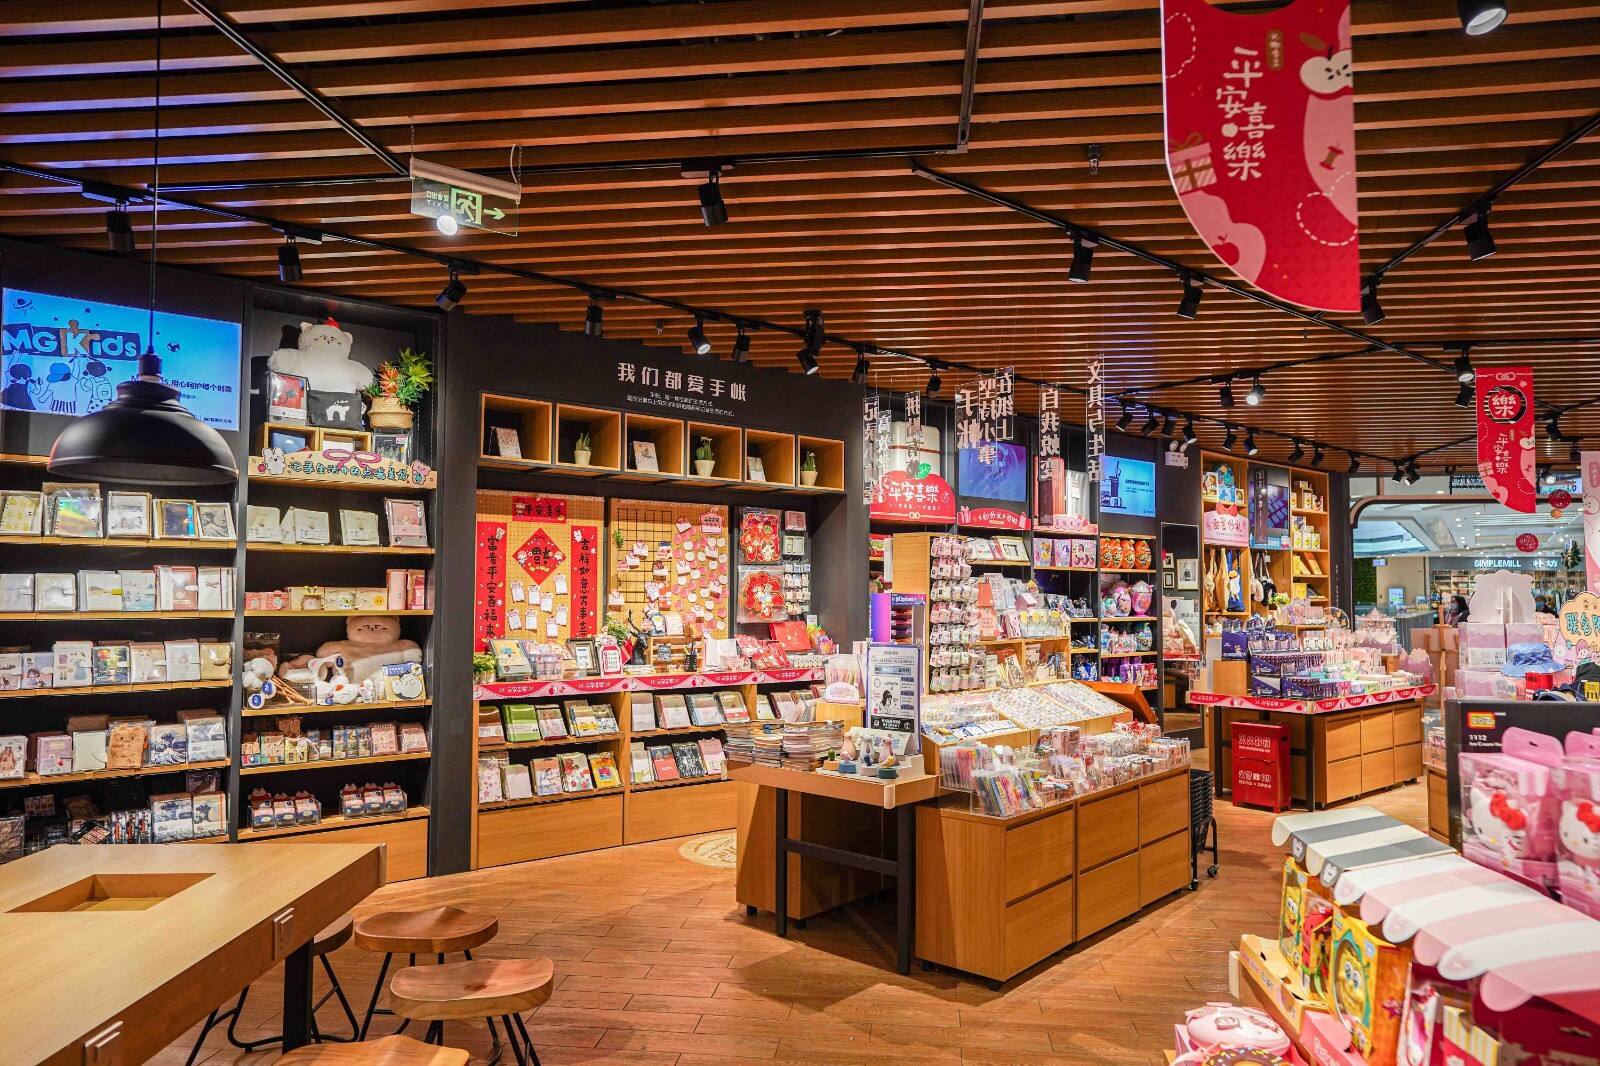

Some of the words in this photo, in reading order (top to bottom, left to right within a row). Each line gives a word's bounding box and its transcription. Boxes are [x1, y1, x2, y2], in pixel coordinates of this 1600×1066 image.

[617, 362, 746, 401] 我们都爱手帐
[1474, 560, 1522, 568] SIMPLEMILL
